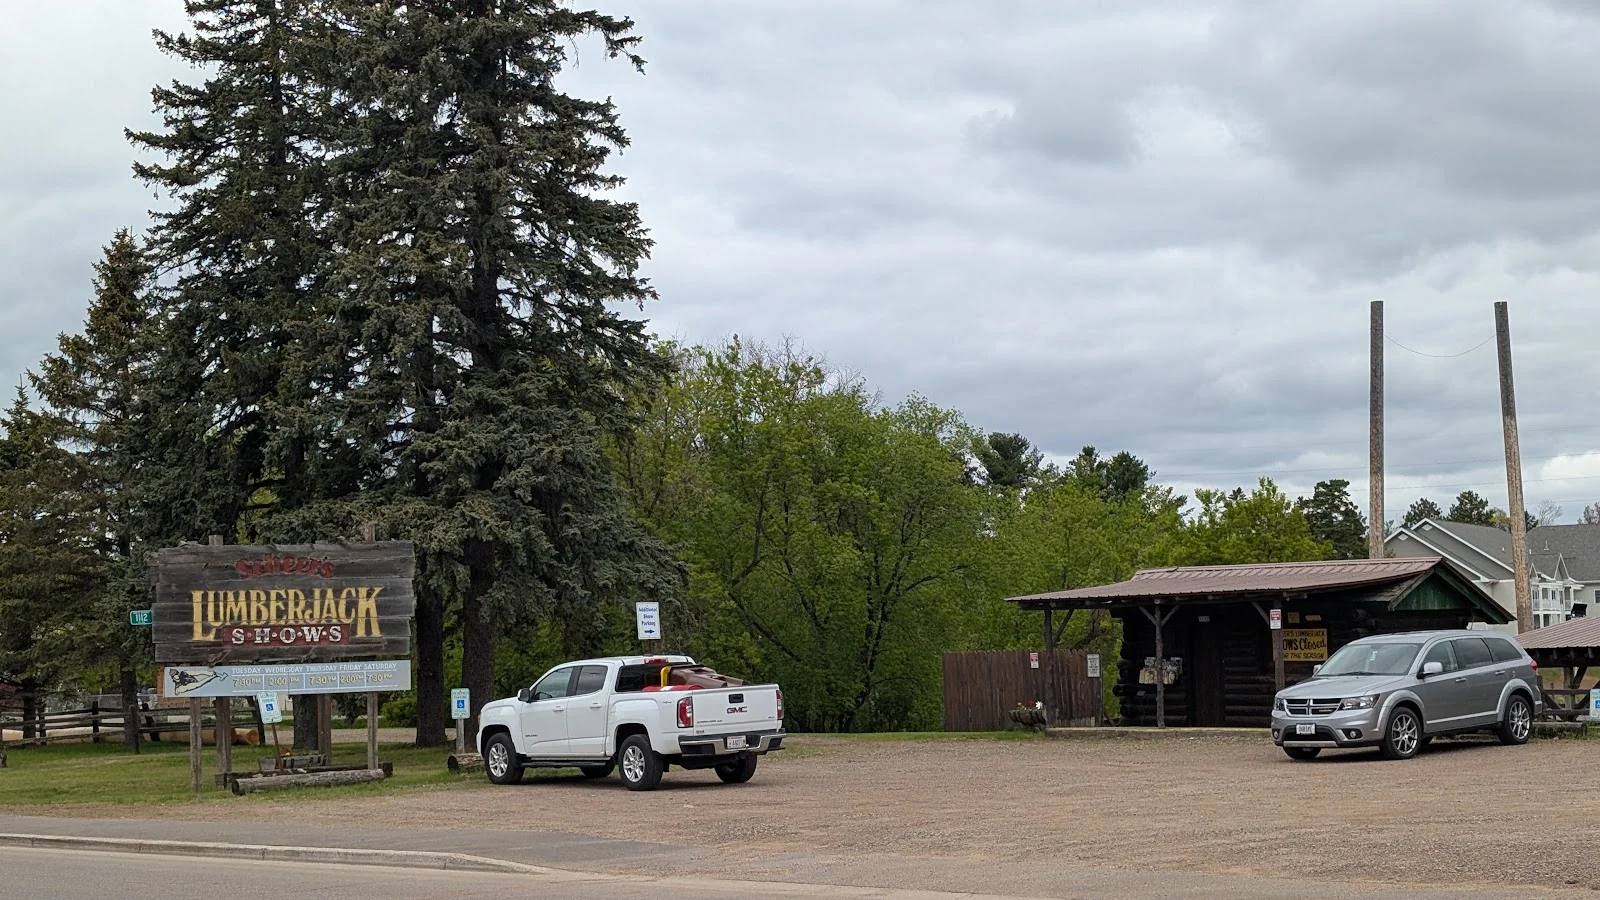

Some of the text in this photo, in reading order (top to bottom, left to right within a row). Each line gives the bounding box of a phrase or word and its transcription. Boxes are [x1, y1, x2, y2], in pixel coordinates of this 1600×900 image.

[191, 585, 385, 641] LUMBERJACK
[232, 667, 261, 675] TUESDAY
[265, 666, 303, 674] WEDNESDAY
[306, 665, 337, 673] THURSDAY
[364, 662, 397, 670] SATURDAY
[726, 706, 747, 714] GMC
